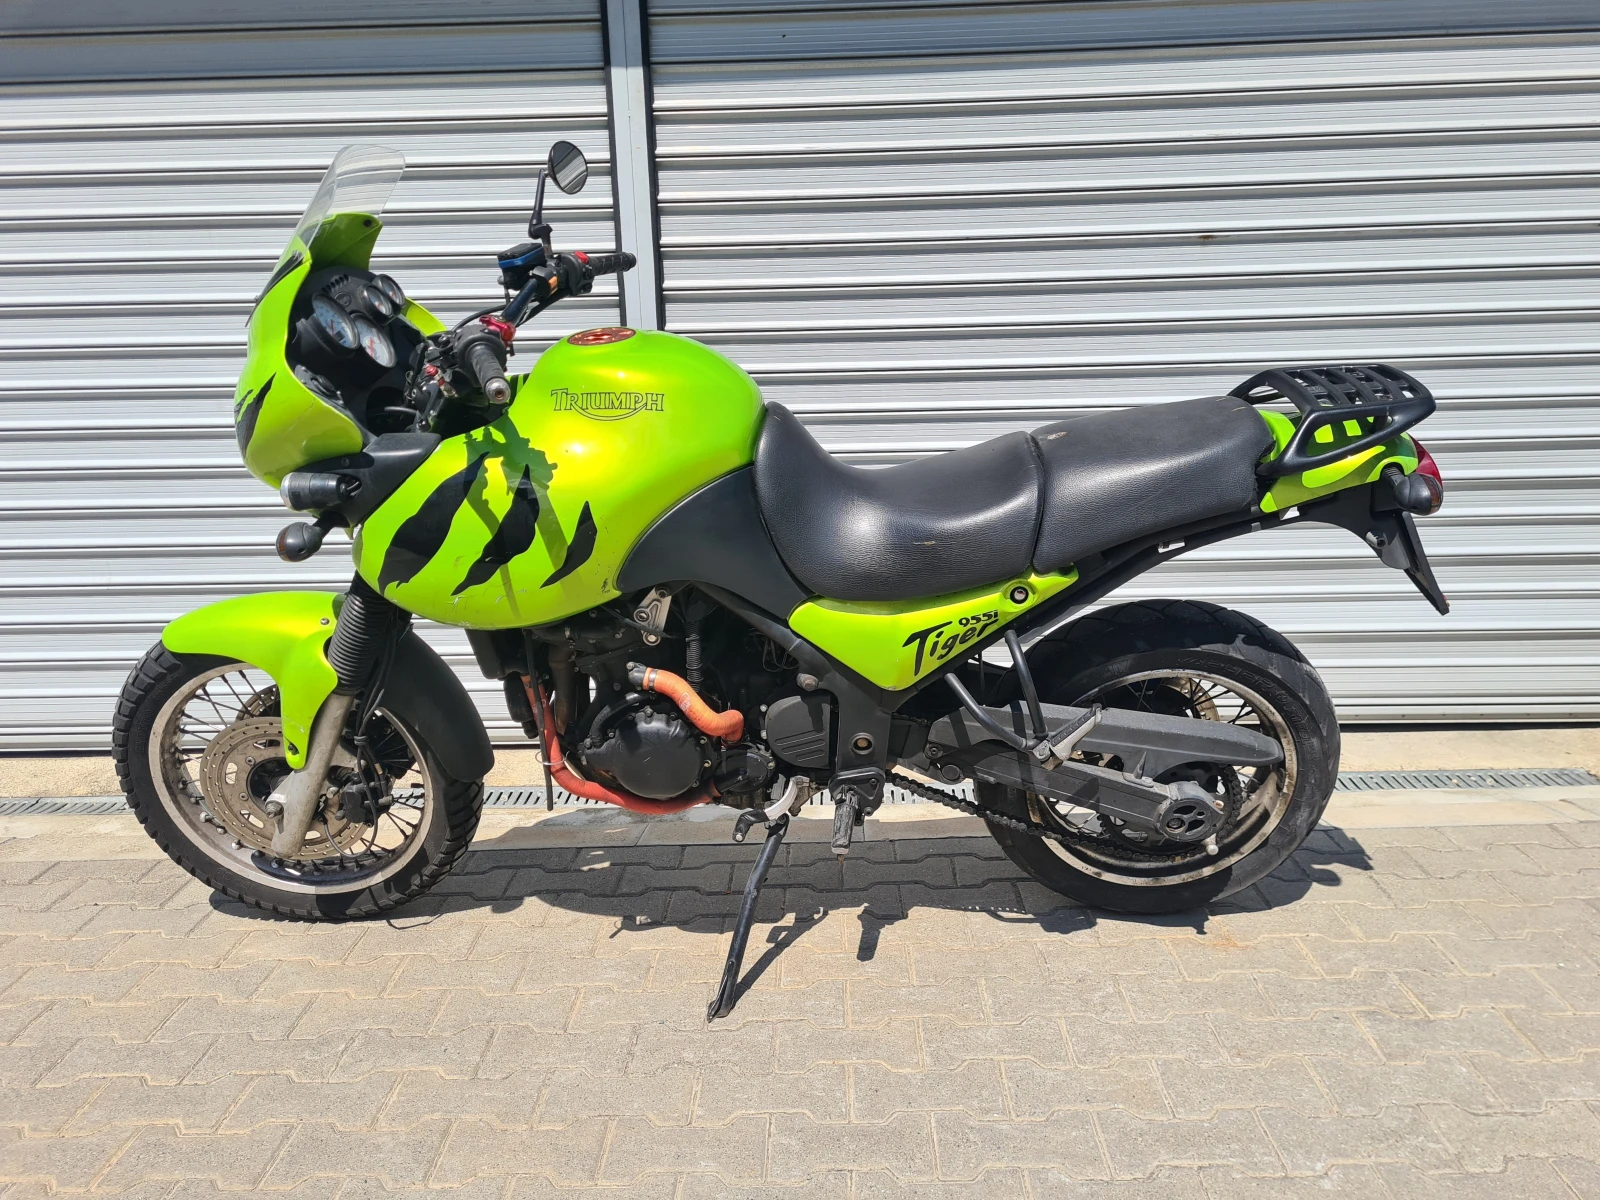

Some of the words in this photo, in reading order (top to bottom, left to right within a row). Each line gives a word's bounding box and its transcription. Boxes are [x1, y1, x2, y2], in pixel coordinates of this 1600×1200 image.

[551, 388, 665, 421] TRIUMPH
[958, 610, 998, 627] 955i
[902, 618, 999, 676] Tiger
